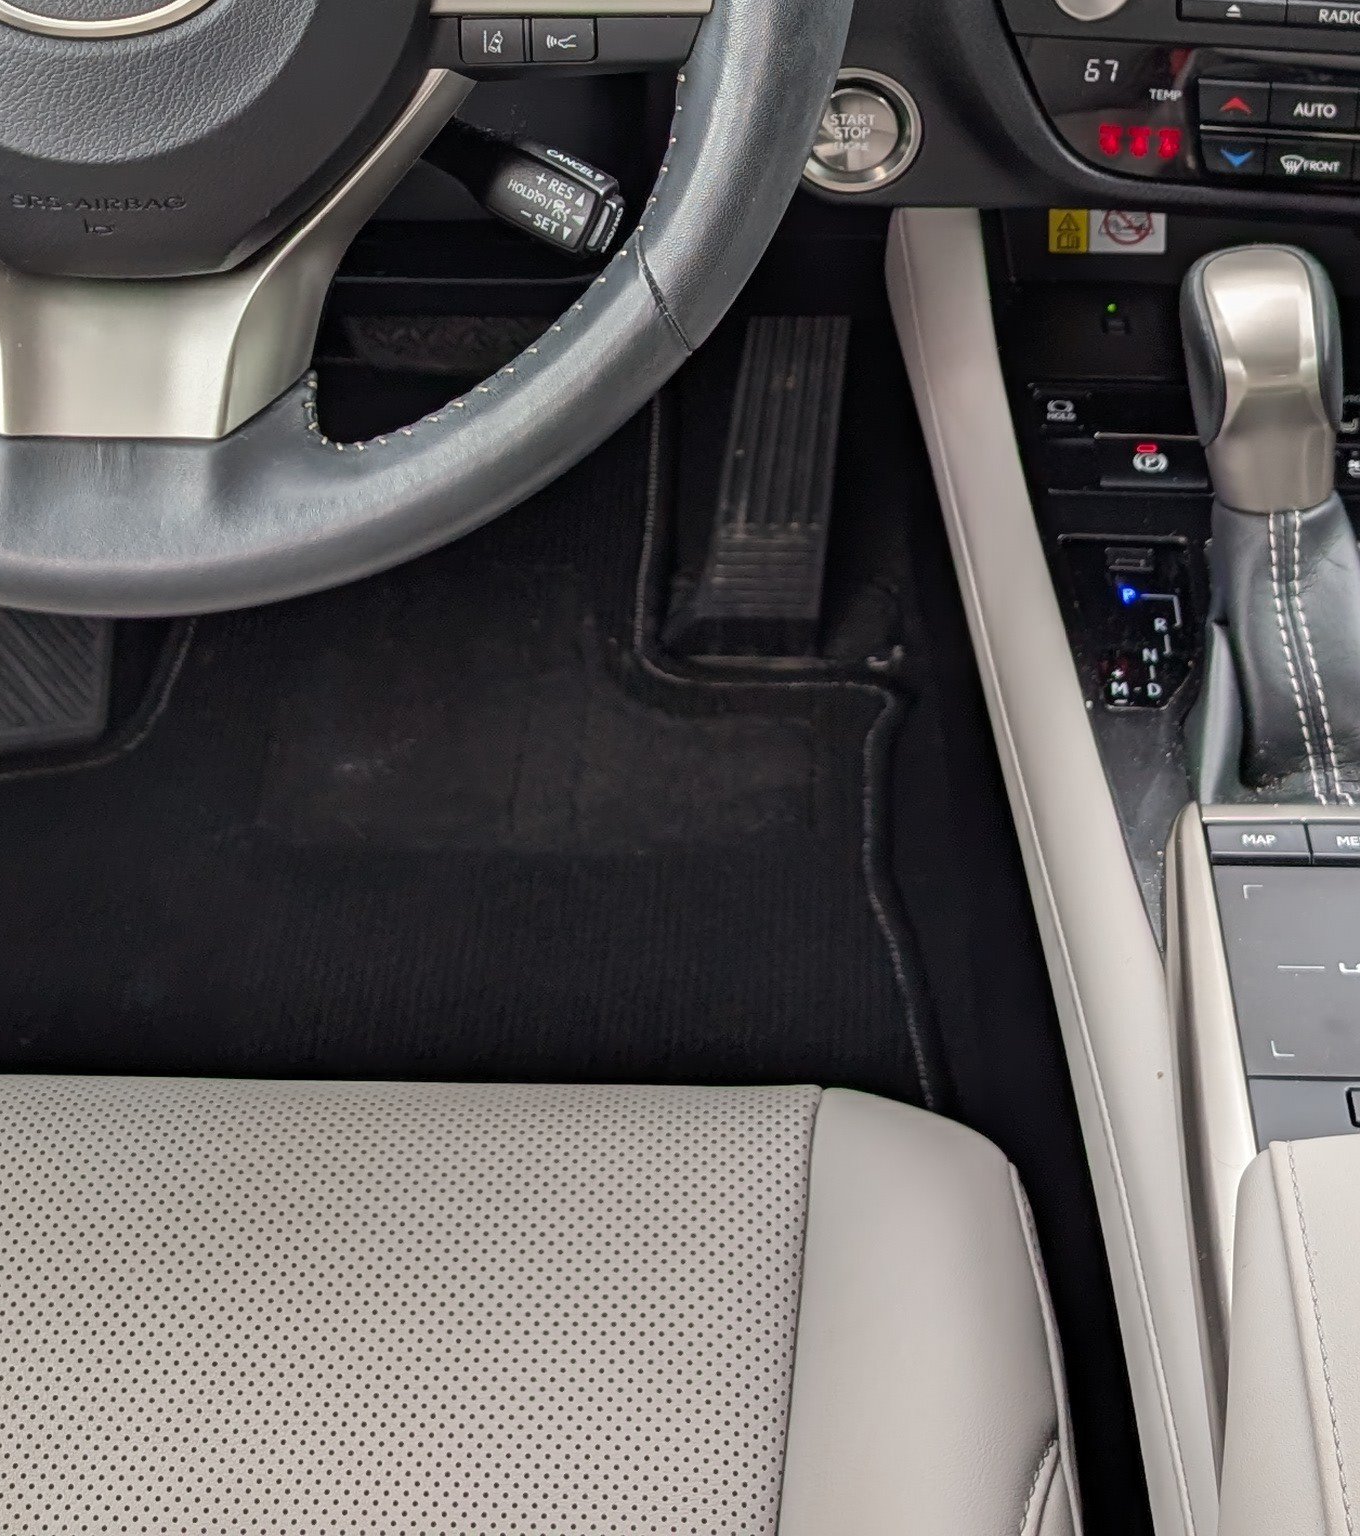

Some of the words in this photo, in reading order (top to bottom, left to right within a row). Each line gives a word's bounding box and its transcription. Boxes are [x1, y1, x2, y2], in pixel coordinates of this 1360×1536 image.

[1083, 59, 1119, 83] 67
[1149, 88, 1182, 102] TEMP
[1293, 102, 1337, 119] AUTO
[830, 113, 876, 126] START
[834, 126, 871, 141] STOP
[546, 148, 594, 179] CANCEL
[1304, 159, 1341, 174] FRONT
[507, 178, 535, 200] HOLD
[547, 177, 576, 200] RES
[533, 213, 560, 235] SET
[1122, 587, 1136, 604] P
[1153, 617, 1168, 632] R
[1142, 647, 1158, 663] N
[1110, 681, 1130, 696] M
[1147, 682, 1163, 697] D
[1241, 833, 1277, 847] MAP
